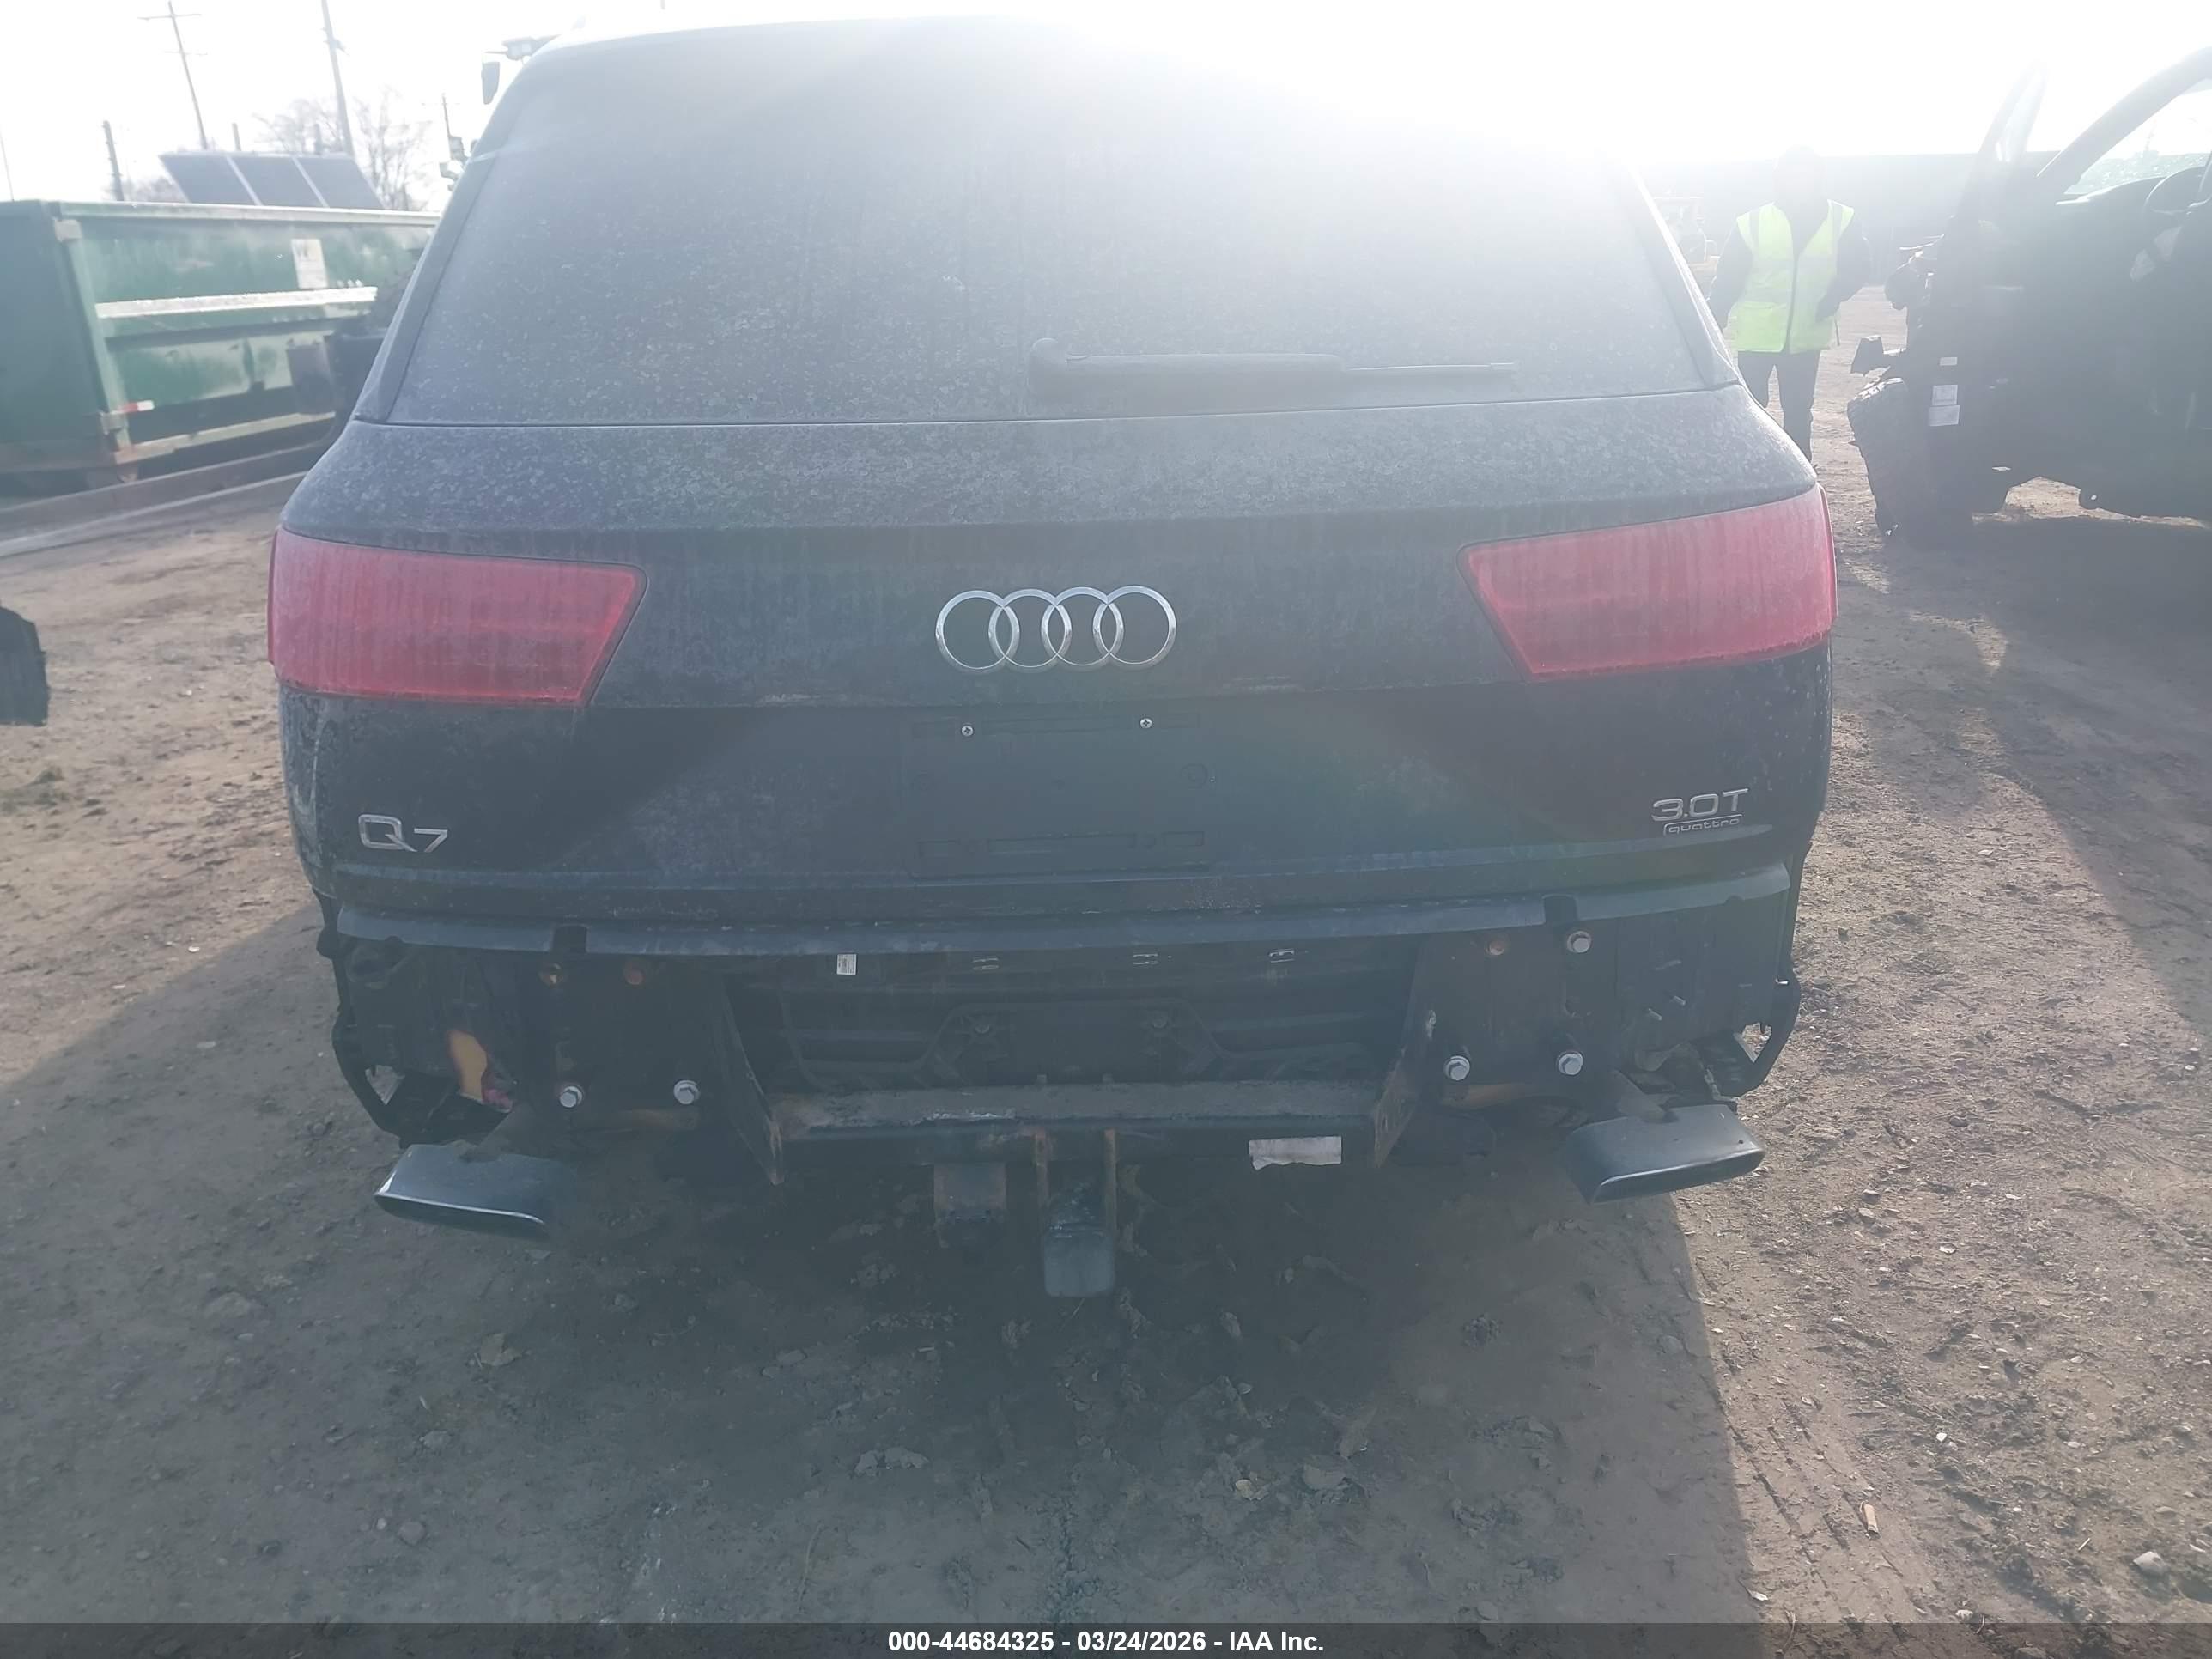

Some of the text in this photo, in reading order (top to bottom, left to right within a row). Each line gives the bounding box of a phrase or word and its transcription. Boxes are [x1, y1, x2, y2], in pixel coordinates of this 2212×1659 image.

[1651, 787, 1749, 822] 3.0T
[358, 814, 448, 852] Q7
[1668, 817, 1741, 836] quattro
